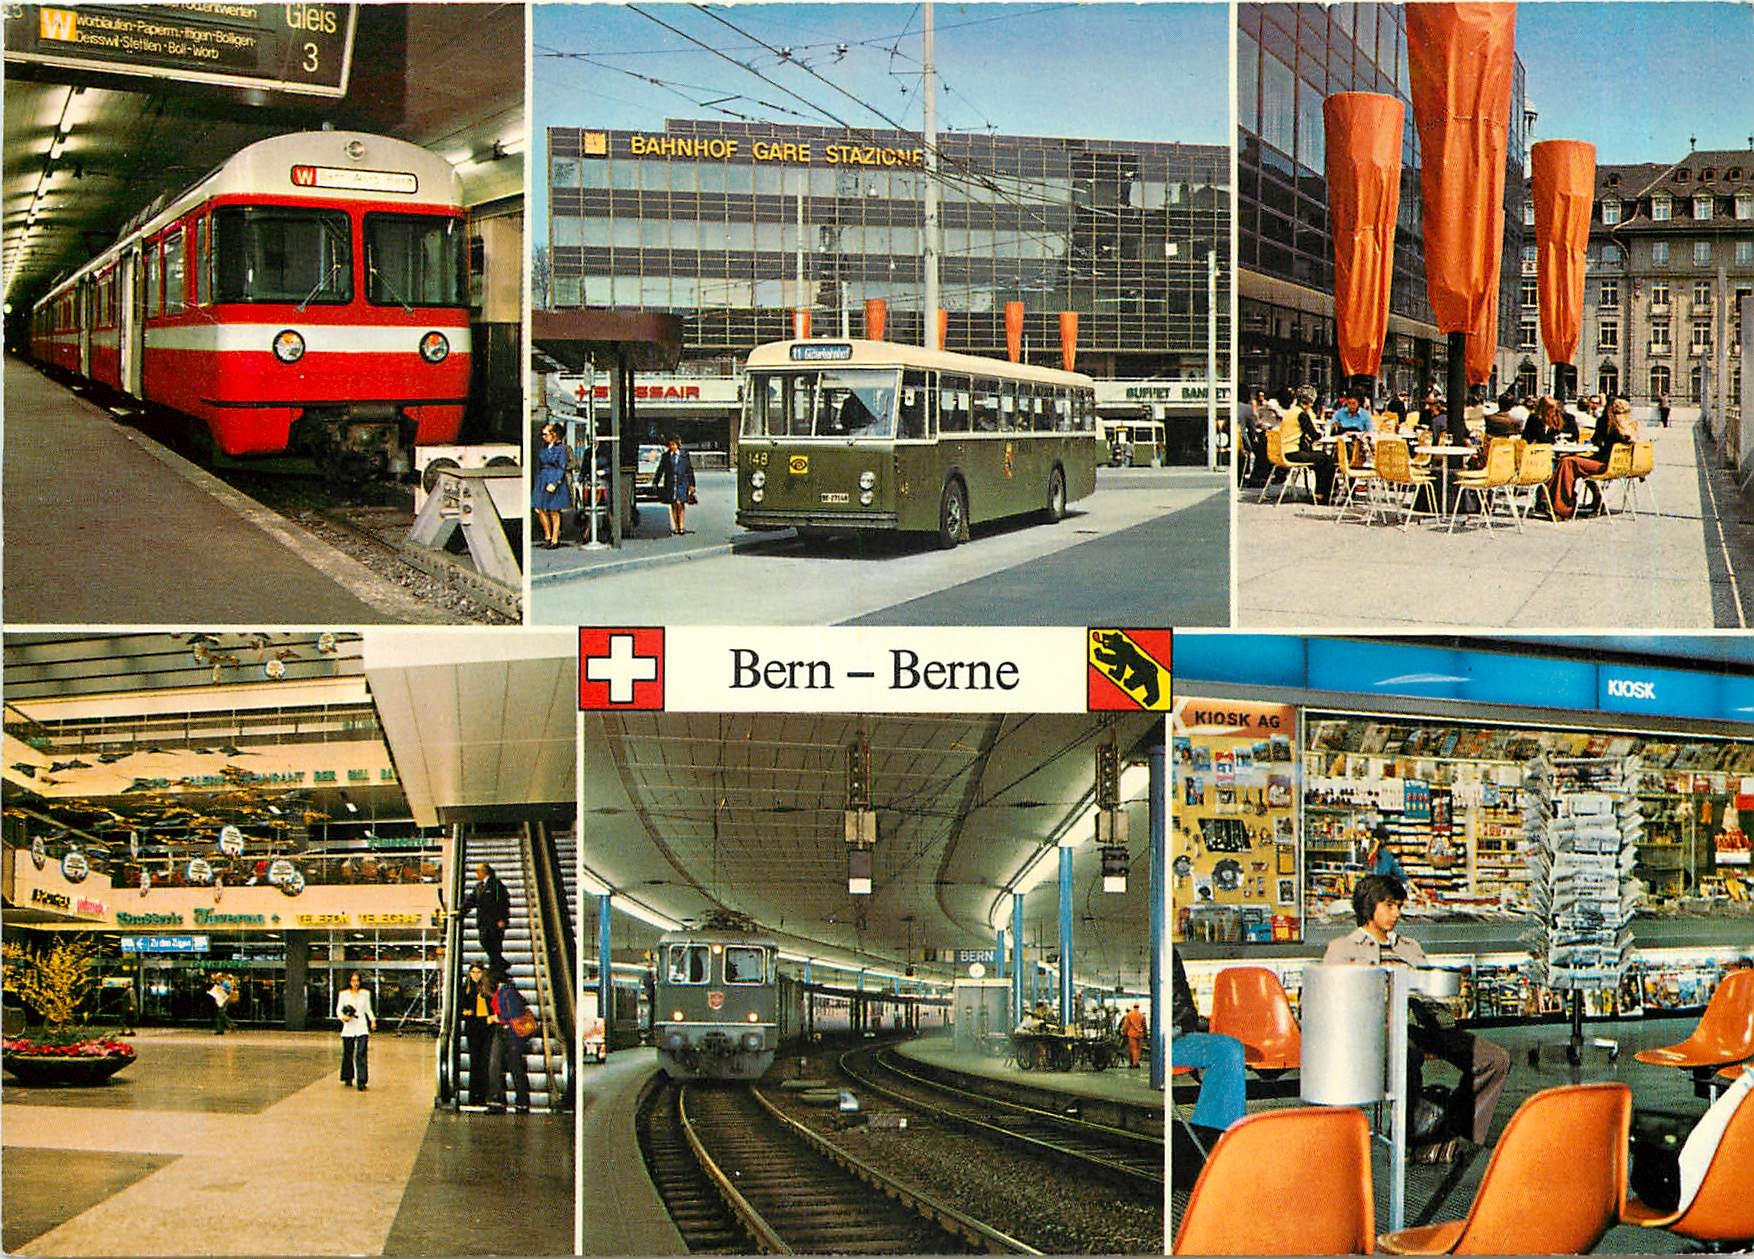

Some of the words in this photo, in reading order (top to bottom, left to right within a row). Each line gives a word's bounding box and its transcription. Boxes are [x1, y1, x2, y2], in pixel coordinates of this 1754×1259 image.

[42, 10, 73, 41] W
[286, 3, 337, 33] Gleis
[303, 42, 319, 72] 3
[631, 135, 739, 159] BAHNHOF
[752, 140, 811, 164] GARE
[296, 168, 314, 186] W
[594, 386, 700, 399] SSSAIR
[1608, 679, 1656, 699] KIOSK
[1195, 711, 1251, 727] KIOSK
[1258, 714, 1281, 728] AG
[960, 950, 995, 962] BERN
